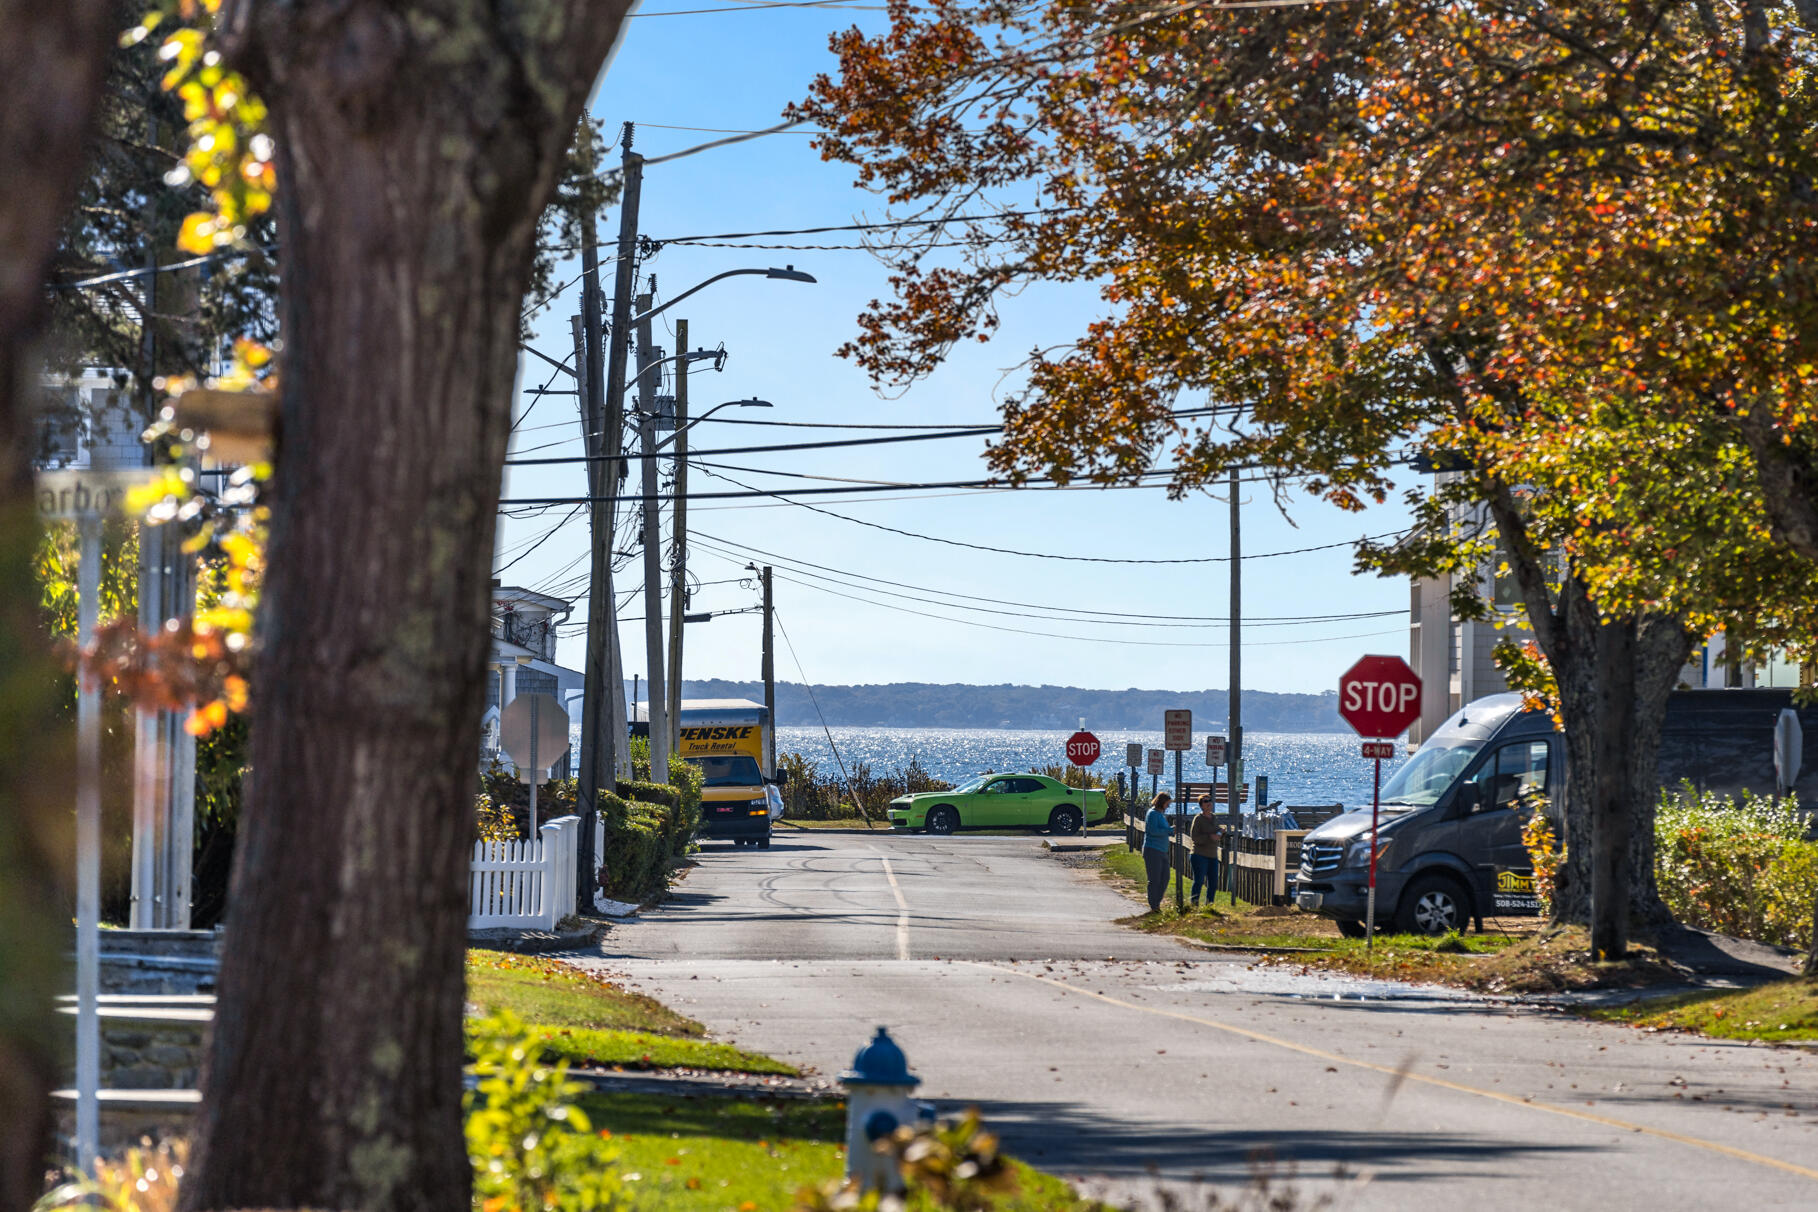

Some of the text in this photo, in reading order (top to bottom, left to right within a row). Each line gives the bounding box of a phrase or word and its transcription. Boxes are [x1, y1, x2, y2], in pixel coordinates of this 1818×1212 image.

[1344, 681, 1418, 713] STOP
[689, 742, 737, 751] Truck Rental
[1068, 742, 1098, 756] STOP
[1364, 745, 1392, 755] 4-WAY
[1496, 900, 1541, 908] 508-524-151
